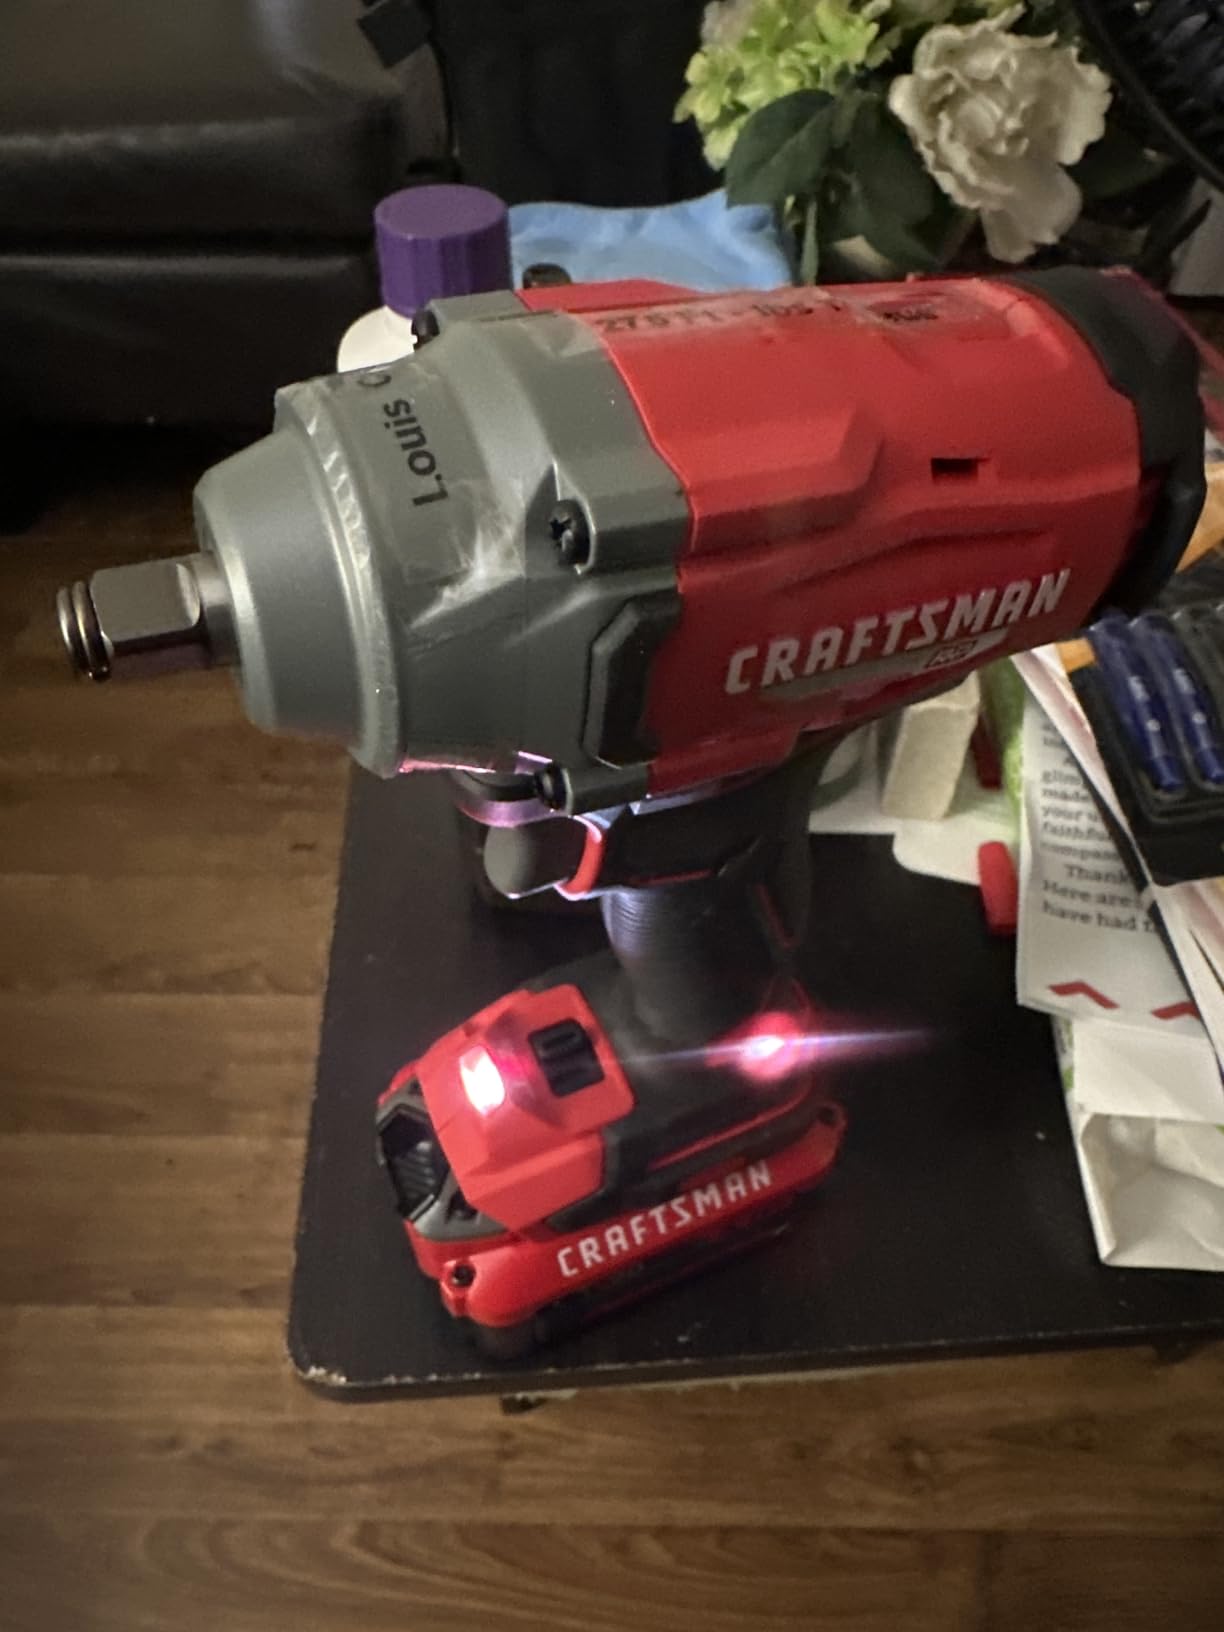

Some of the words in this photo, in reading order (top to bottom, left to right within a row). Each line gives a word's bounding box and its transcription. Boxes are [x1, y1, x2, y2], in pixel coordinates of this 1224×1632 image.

[384, 399, 448, 506] Louis
[725, 568, 1071, 695] CRAFTSMAN
[1042, 880, 1092, 902] Here
[1042, 900, 1092, 922] have
[1096, 913, 1137, 931] had
[557, 1161, 771, 1276] CRAFTSMAN
